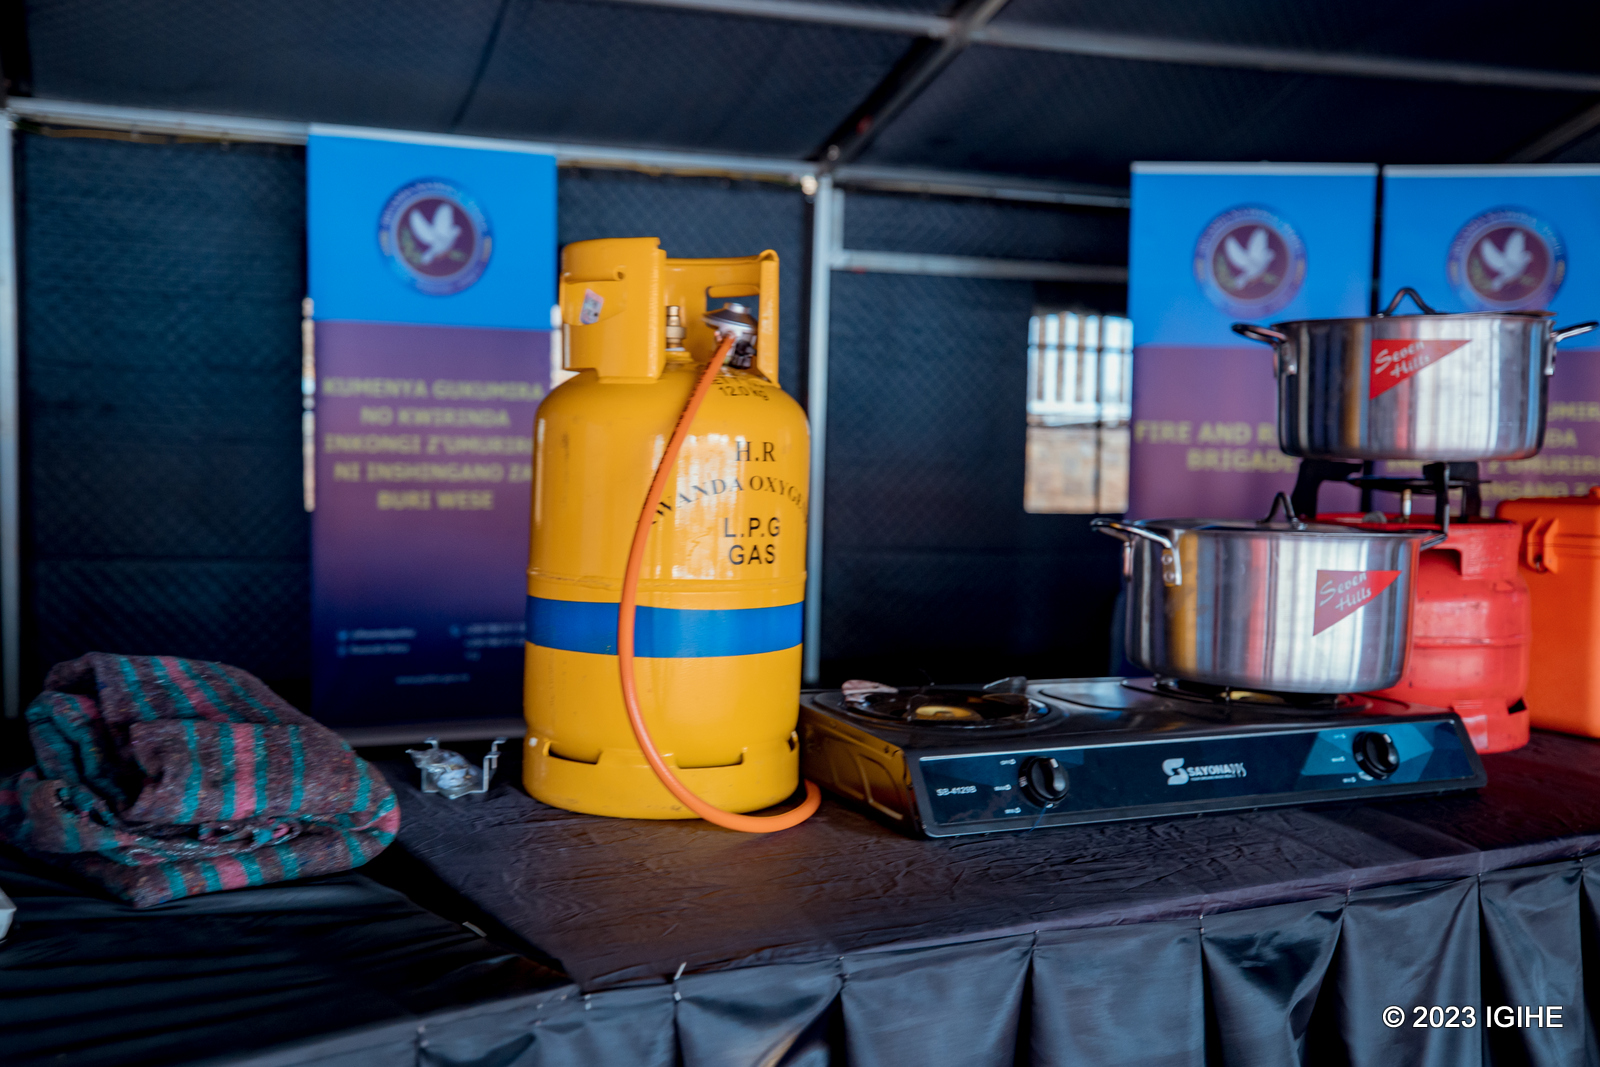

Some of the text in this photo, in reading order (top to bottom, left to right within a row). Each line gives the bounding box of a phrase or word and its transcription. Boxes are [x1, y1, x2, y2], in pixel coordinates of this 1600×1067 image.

[1374, 341, 1424, 375] Seven
[1389, 354, 1430, 378] Hills
[360, 406, 393, 426] NO
[1134, 420, 1191, 444] FIRE
[1198, 421, 1252, 445] AND
[736, 441, 776, 461] H.R
[637, 477, 744, 525] WANDA
[724, 517, 780, 538] L.P.G
[729, 544, 775, 565] GAS
[1319, 572, 1367, 607] Seven
[1334, 587, 1372, 611] Hills
